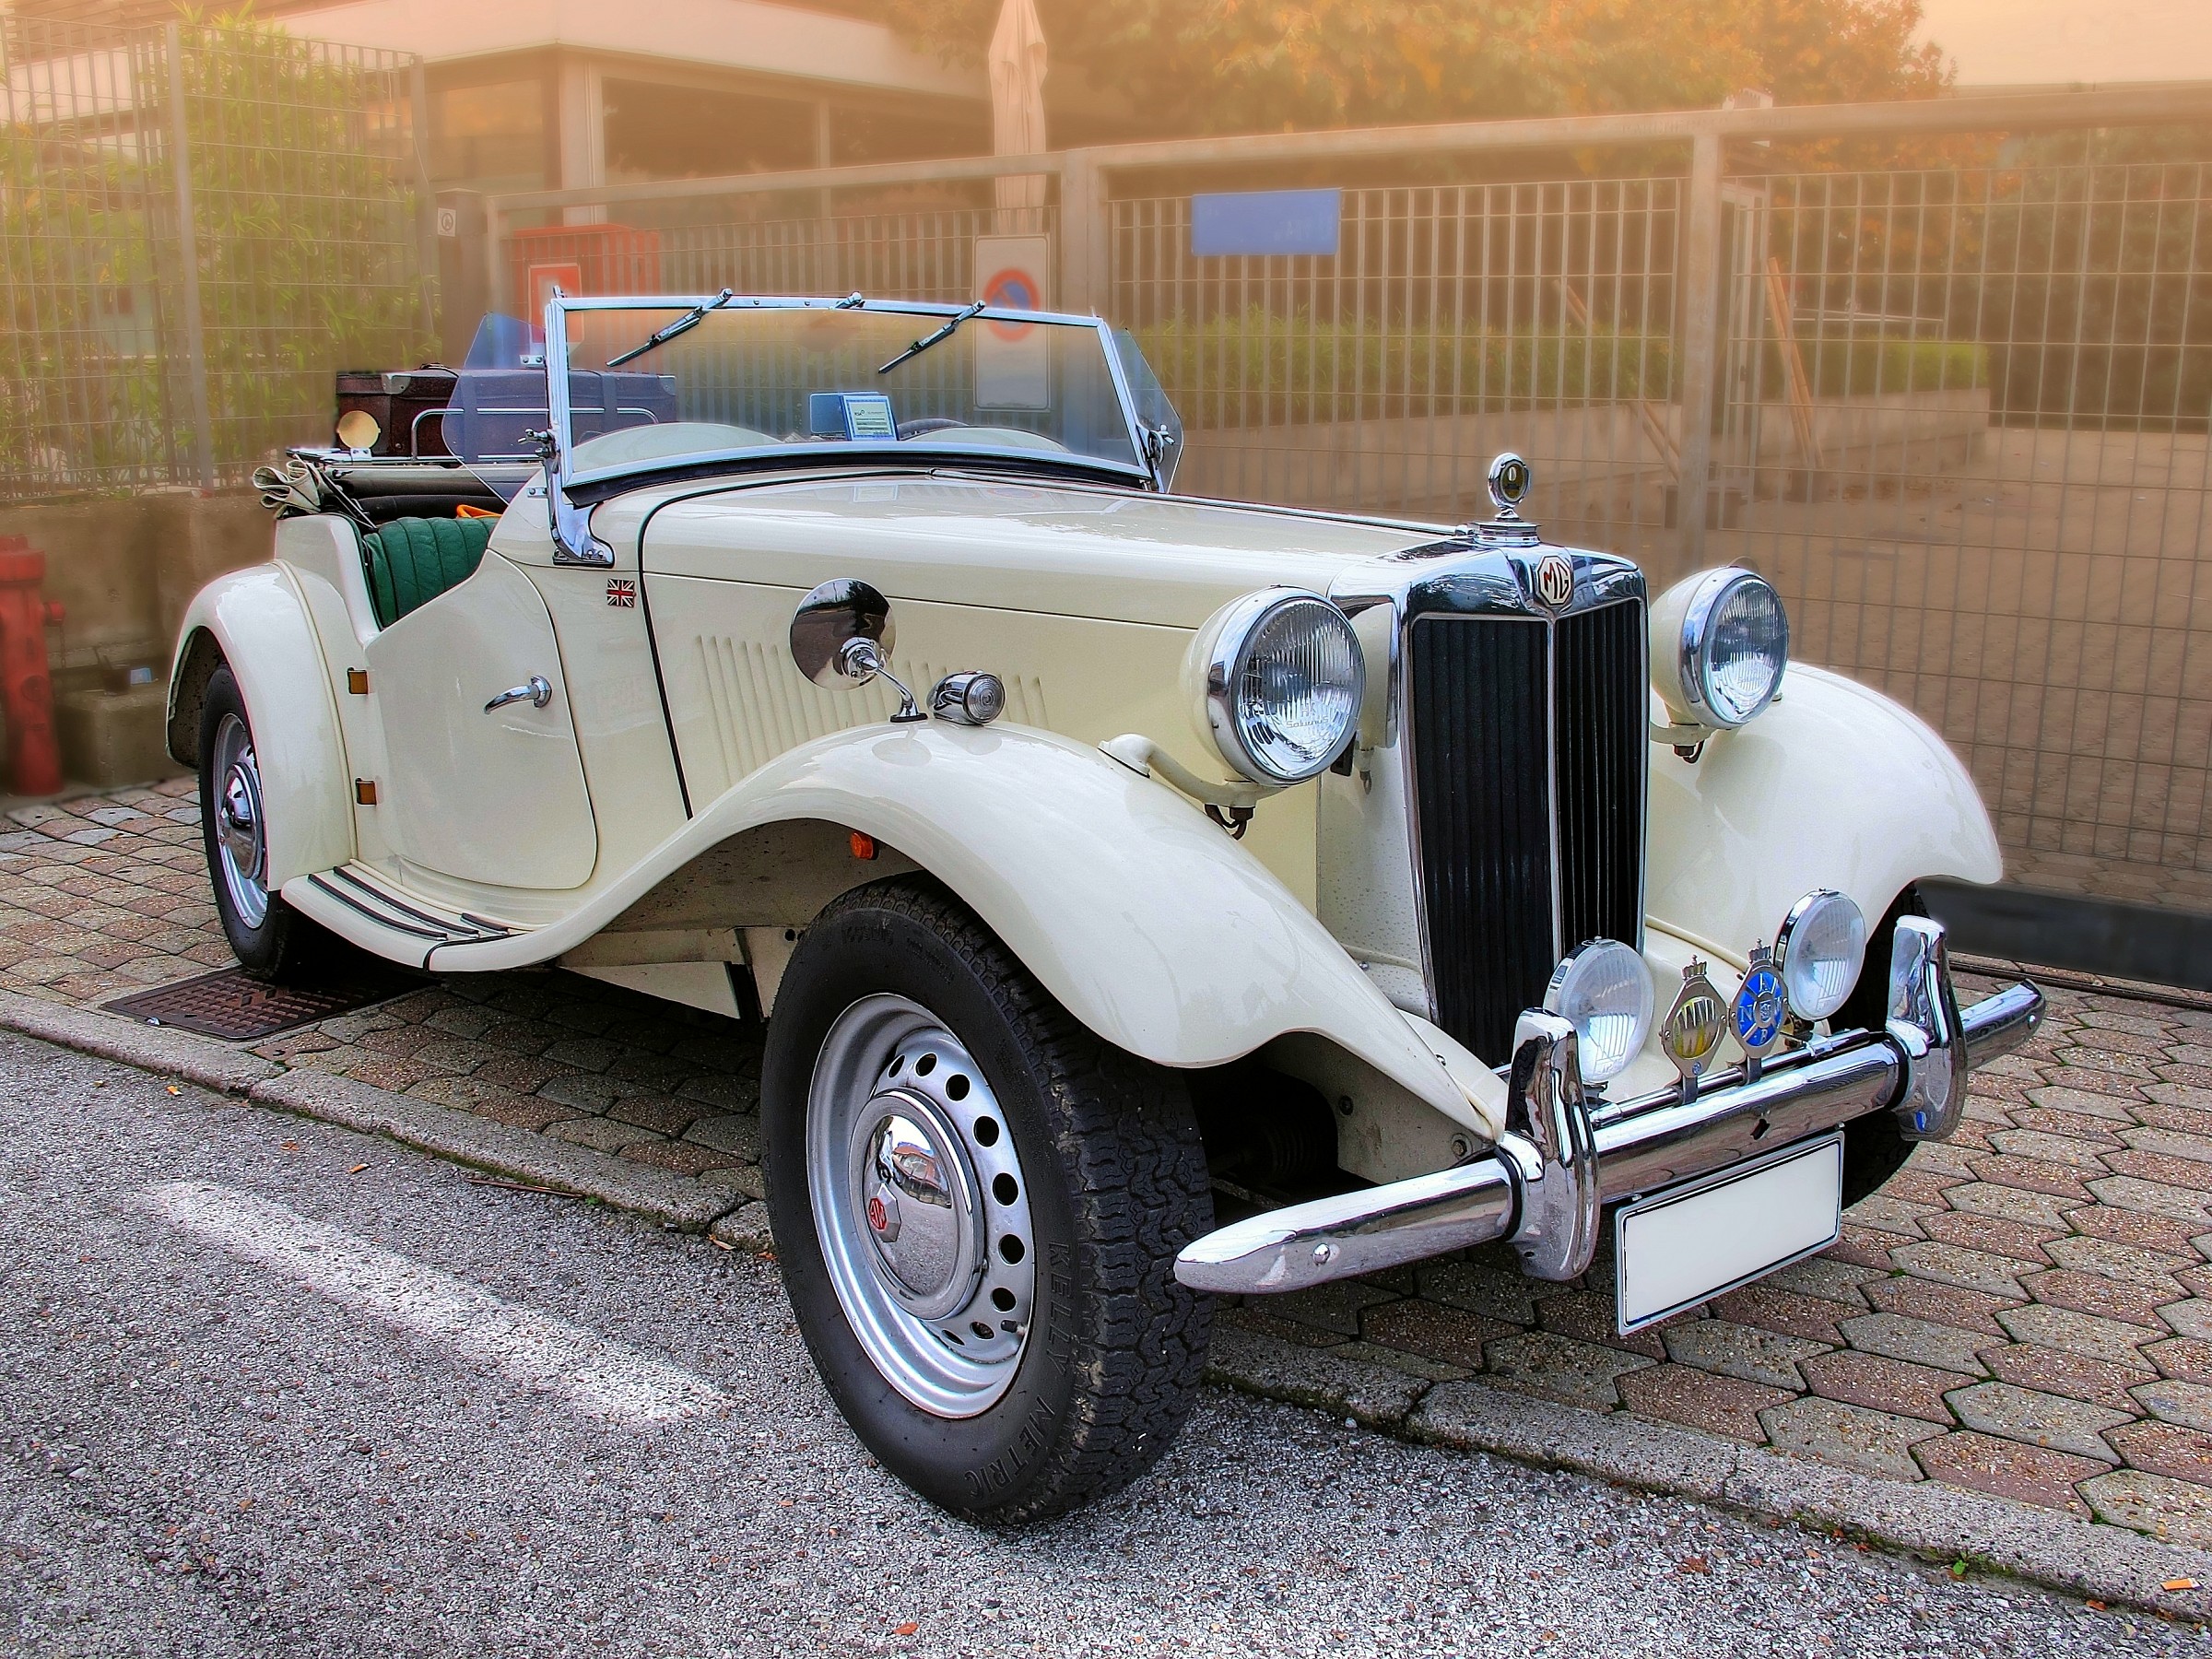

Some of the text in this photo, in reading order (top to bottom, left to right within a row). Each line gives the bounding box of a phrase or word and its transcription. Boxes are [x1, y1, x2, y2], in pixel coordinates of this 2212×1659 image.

[1543, 561, 1570, 600] MG
[870, 1200, 886, 1229] MG
[964, 1241, 1073, 1499] KELLY METRIC
